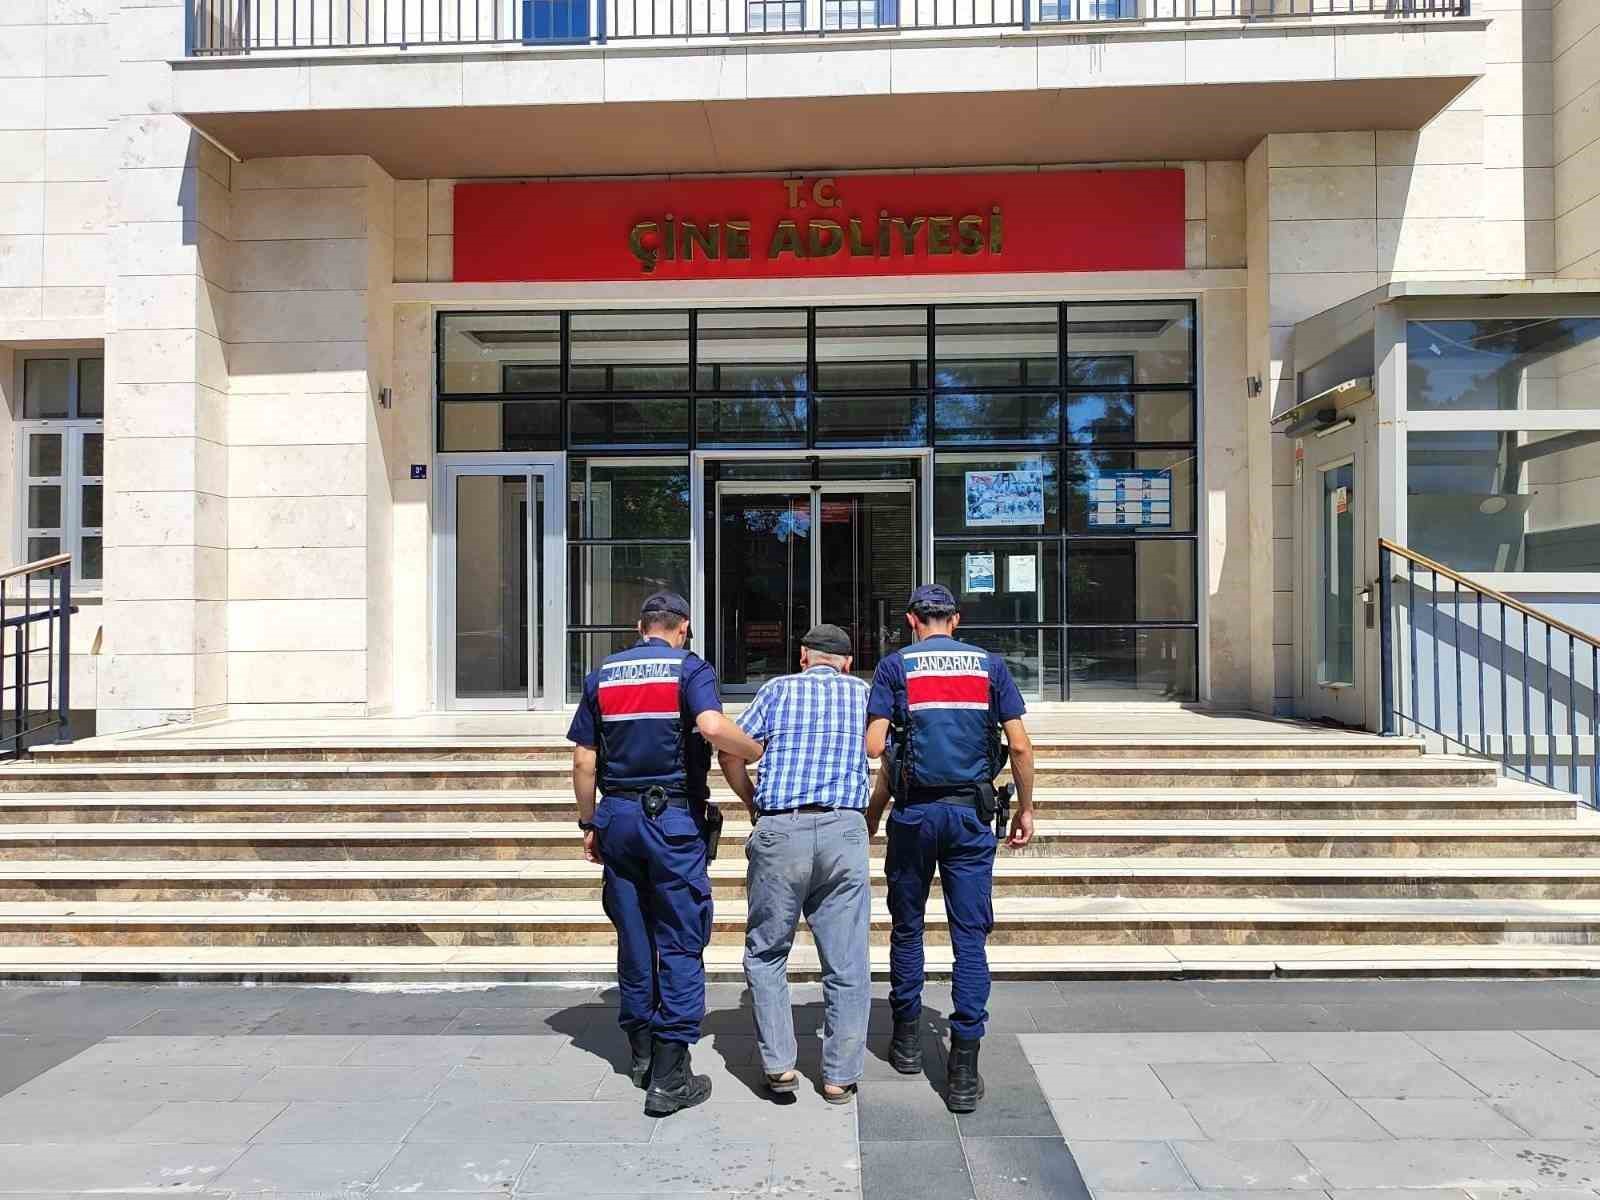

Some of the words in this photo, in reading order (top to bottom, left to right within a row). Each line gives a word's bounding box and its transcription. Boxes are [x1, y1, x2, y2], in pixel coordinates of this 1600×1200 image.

[630, 213, 752, 273] ÇİNE
[769, 206, 1002, 260] ADLİYESİ
[607, 663, 672, 681] JANDARMA
[912, 655, 982, 672] JANDARMA
